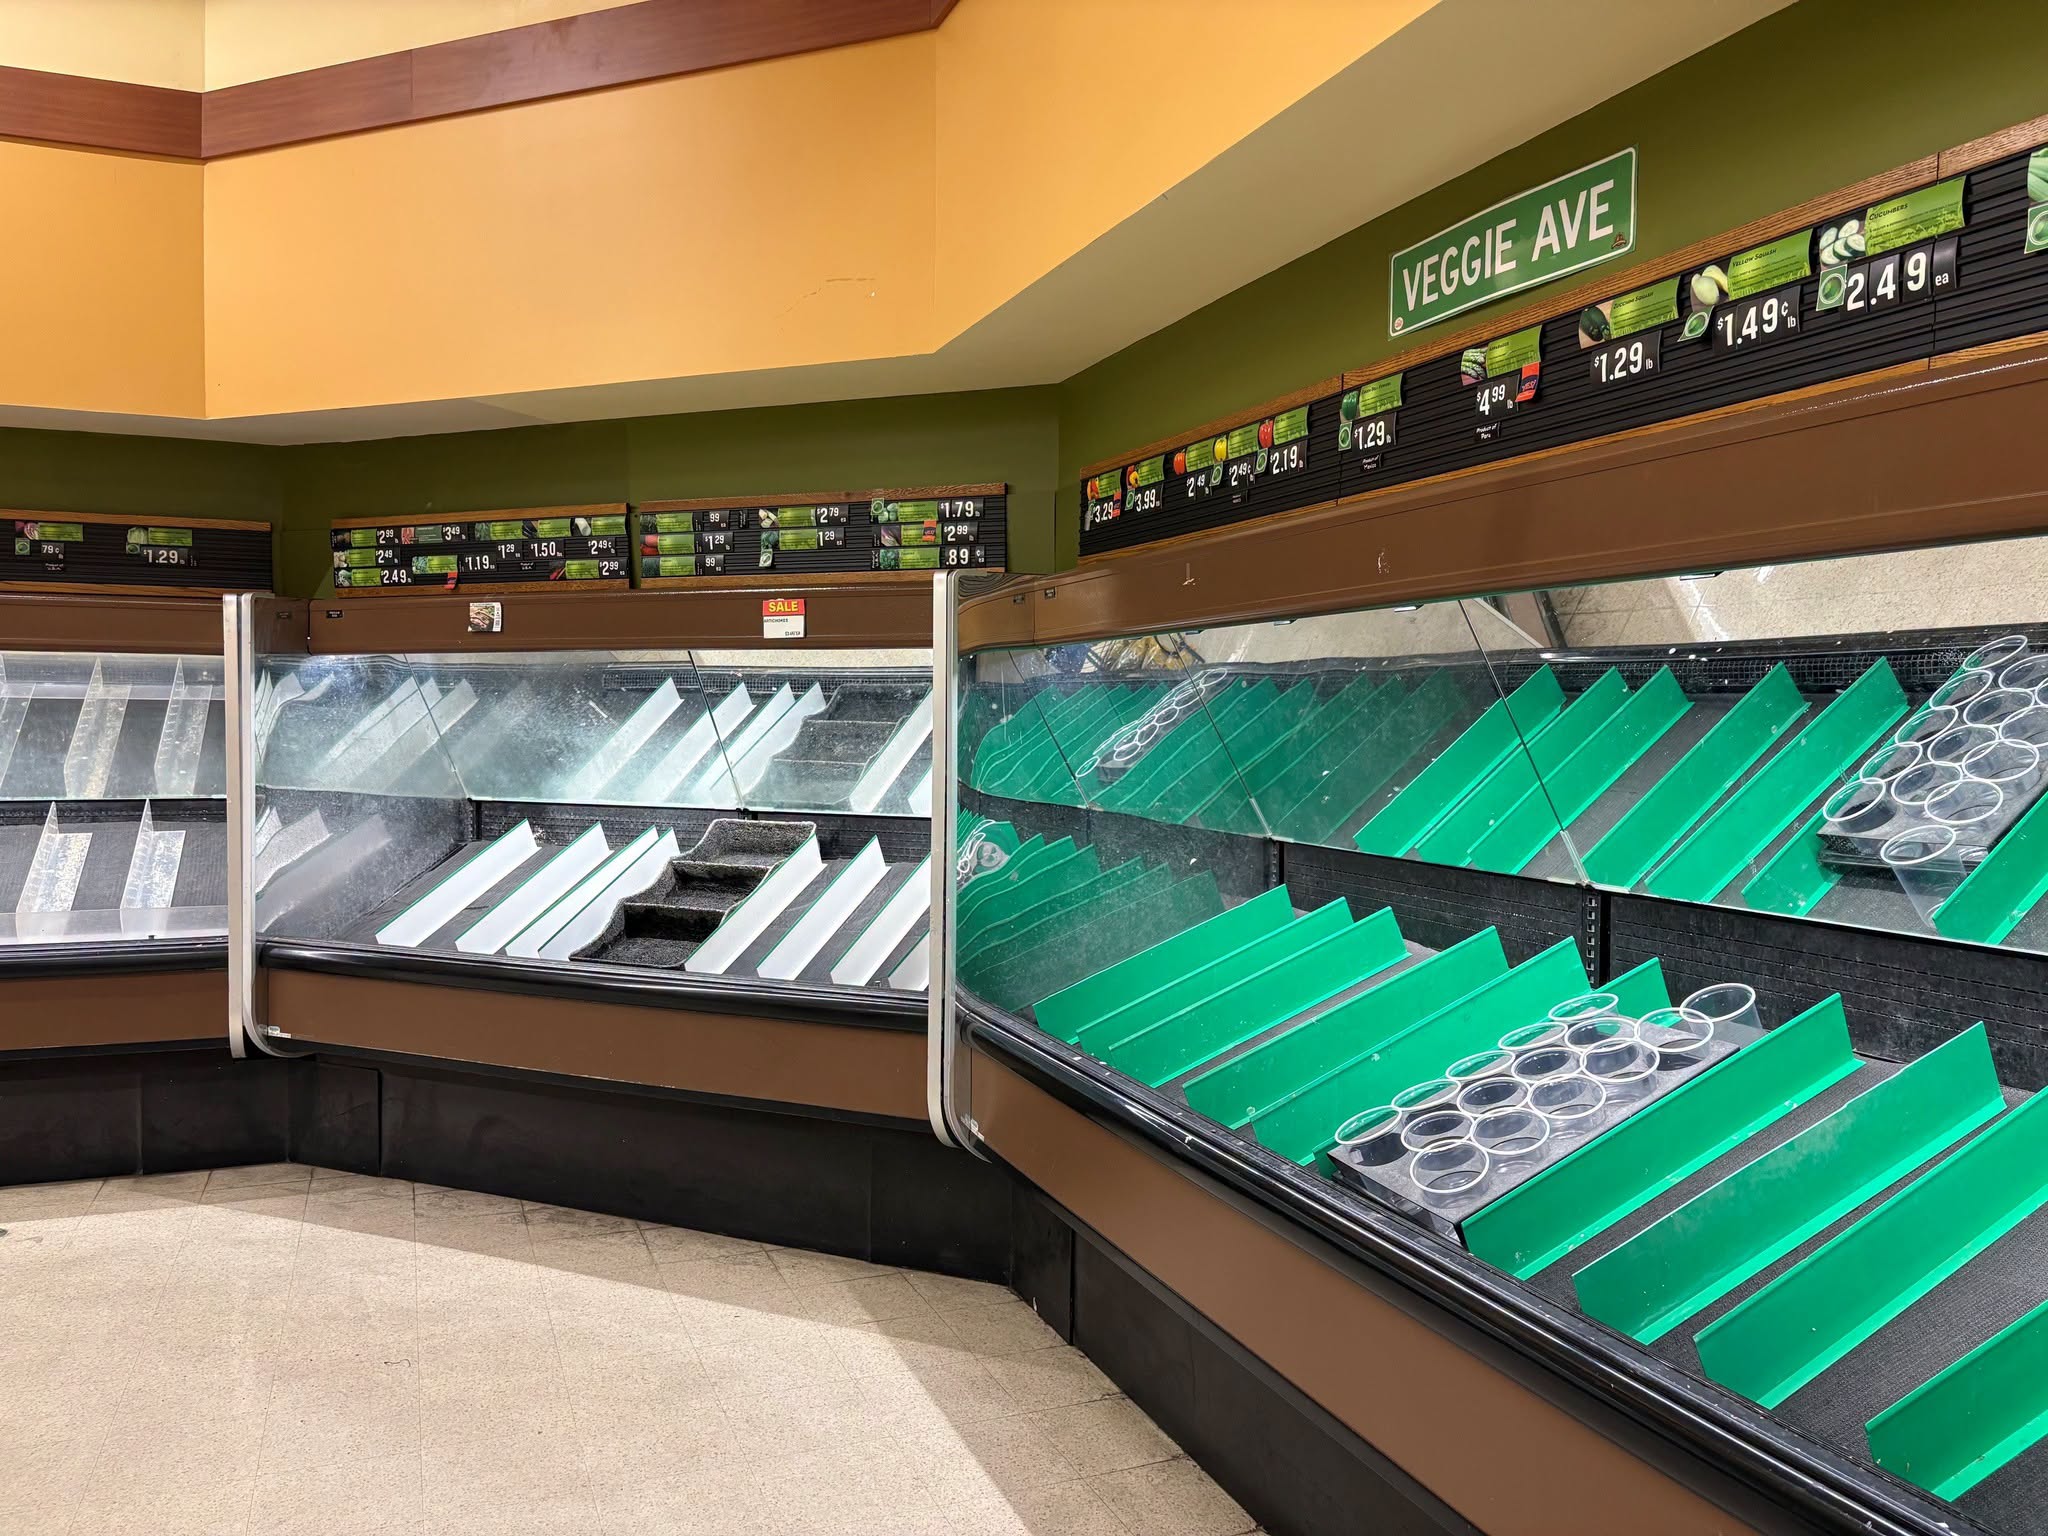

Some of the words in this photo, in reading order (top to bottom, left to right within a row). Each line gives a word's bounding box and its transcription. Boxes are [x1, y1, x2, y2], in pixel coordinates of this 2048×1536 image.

[1403, 219, 1516, 311] VEGGIE
[1531, 179, 1614, 262] AVE
[1845, 252, 1927, 311] 2.49
[1935, 273, 1949, 287] ea
[1787, 316, 1796, 329] lb
[1594, 341, 1644, 383] $1.29
[1645, 358, 1653, 370] lb
[1506, 399, 1514, 409] lb
[1354, 421, 1385, 450] $1.29
[1386, 434, 1392, 444] lb
[1270, 445, 1298, 475] $2.19
[1135, 489, 1156, 512] $3.99
[709, 513, 720, 522] 99
[941, 501, 974, 518] $1.79
[143, 549, 178, 564] $1.29
[531, 541, 556, 557] $1.50
[465, 555, 490, 571] $1.19
[705, 558, 715, 566] 99
[380, 569, 407, 584] $2.49
[768, 601, 799, 612] SALE
